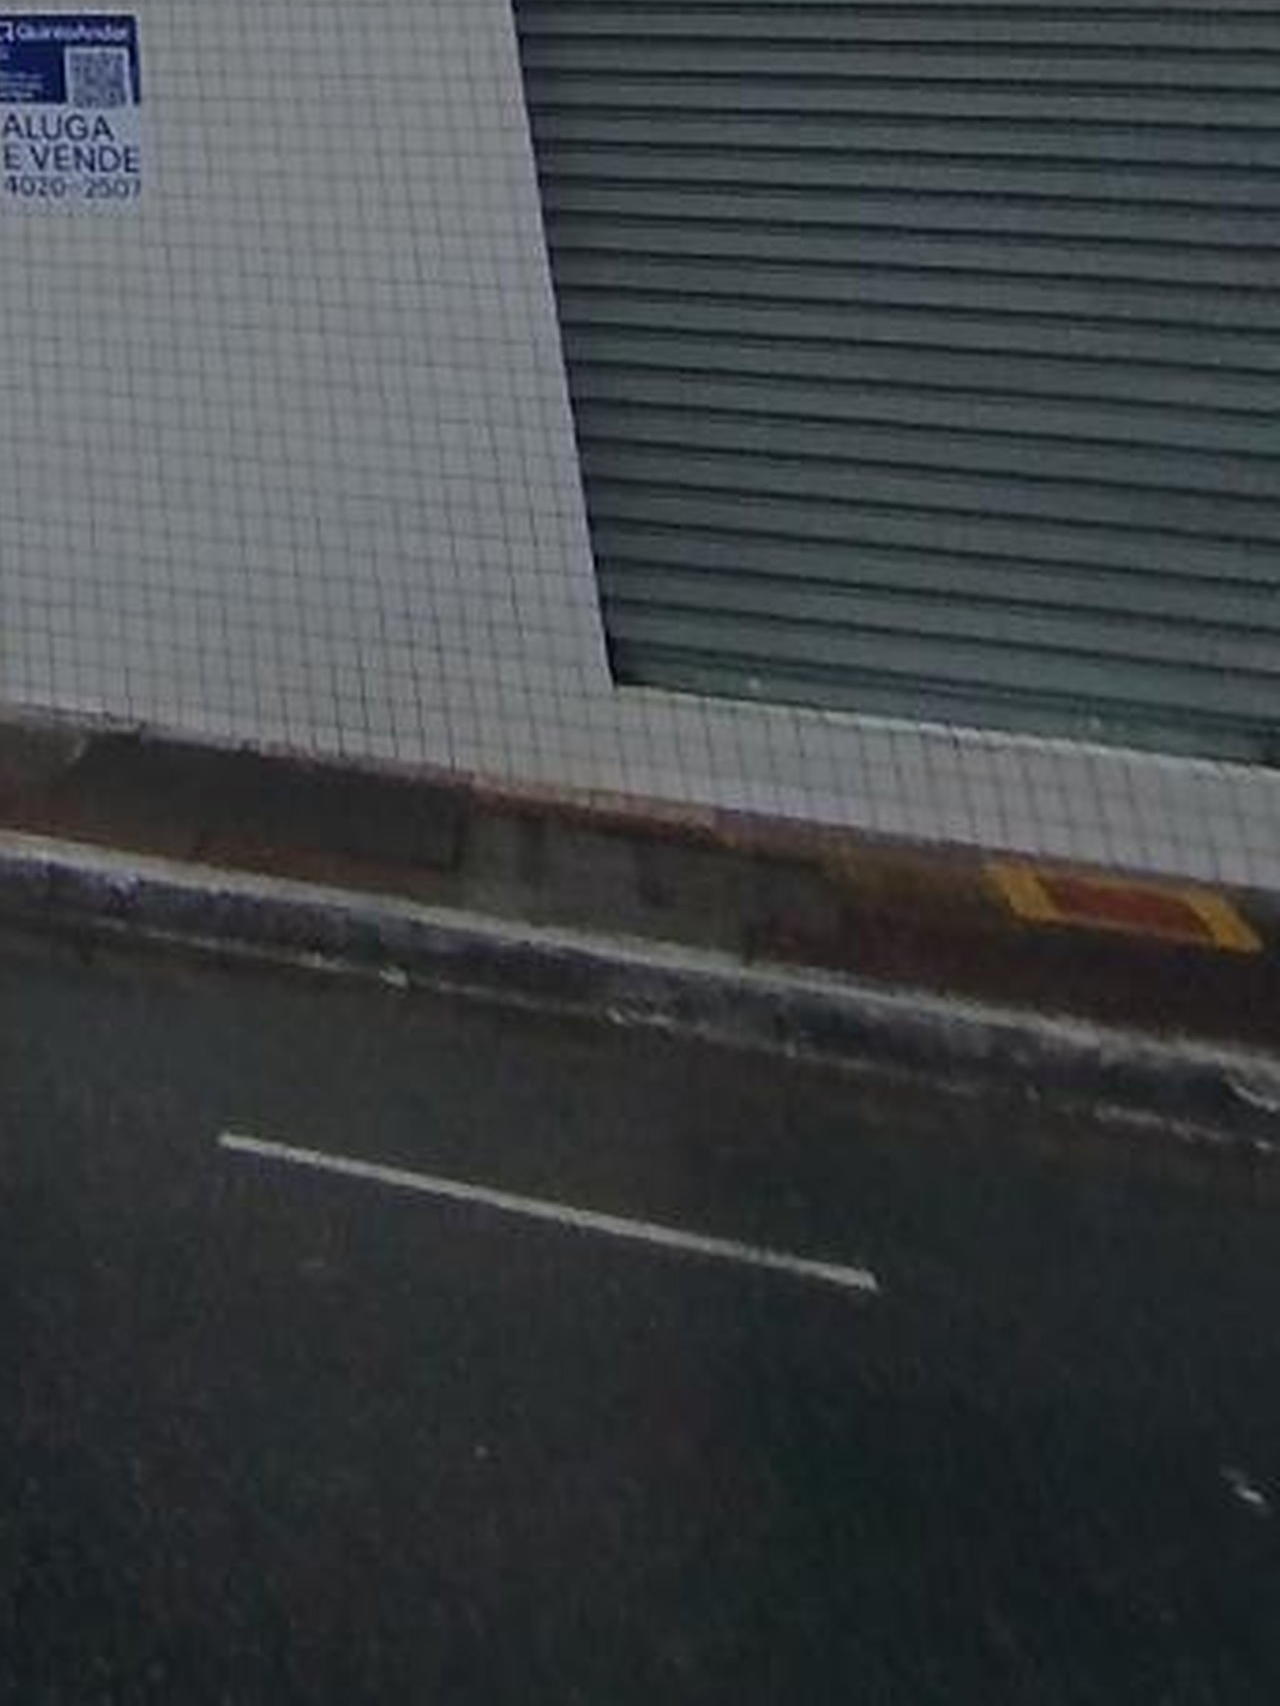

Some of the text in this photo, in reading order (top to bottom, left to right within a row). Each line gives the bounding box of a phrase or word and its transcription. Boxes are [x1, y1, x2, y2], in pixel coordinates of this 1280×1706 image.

[2, 113, 115, 142] ALUGA
[3, 144, 140, 174] E VENDE
